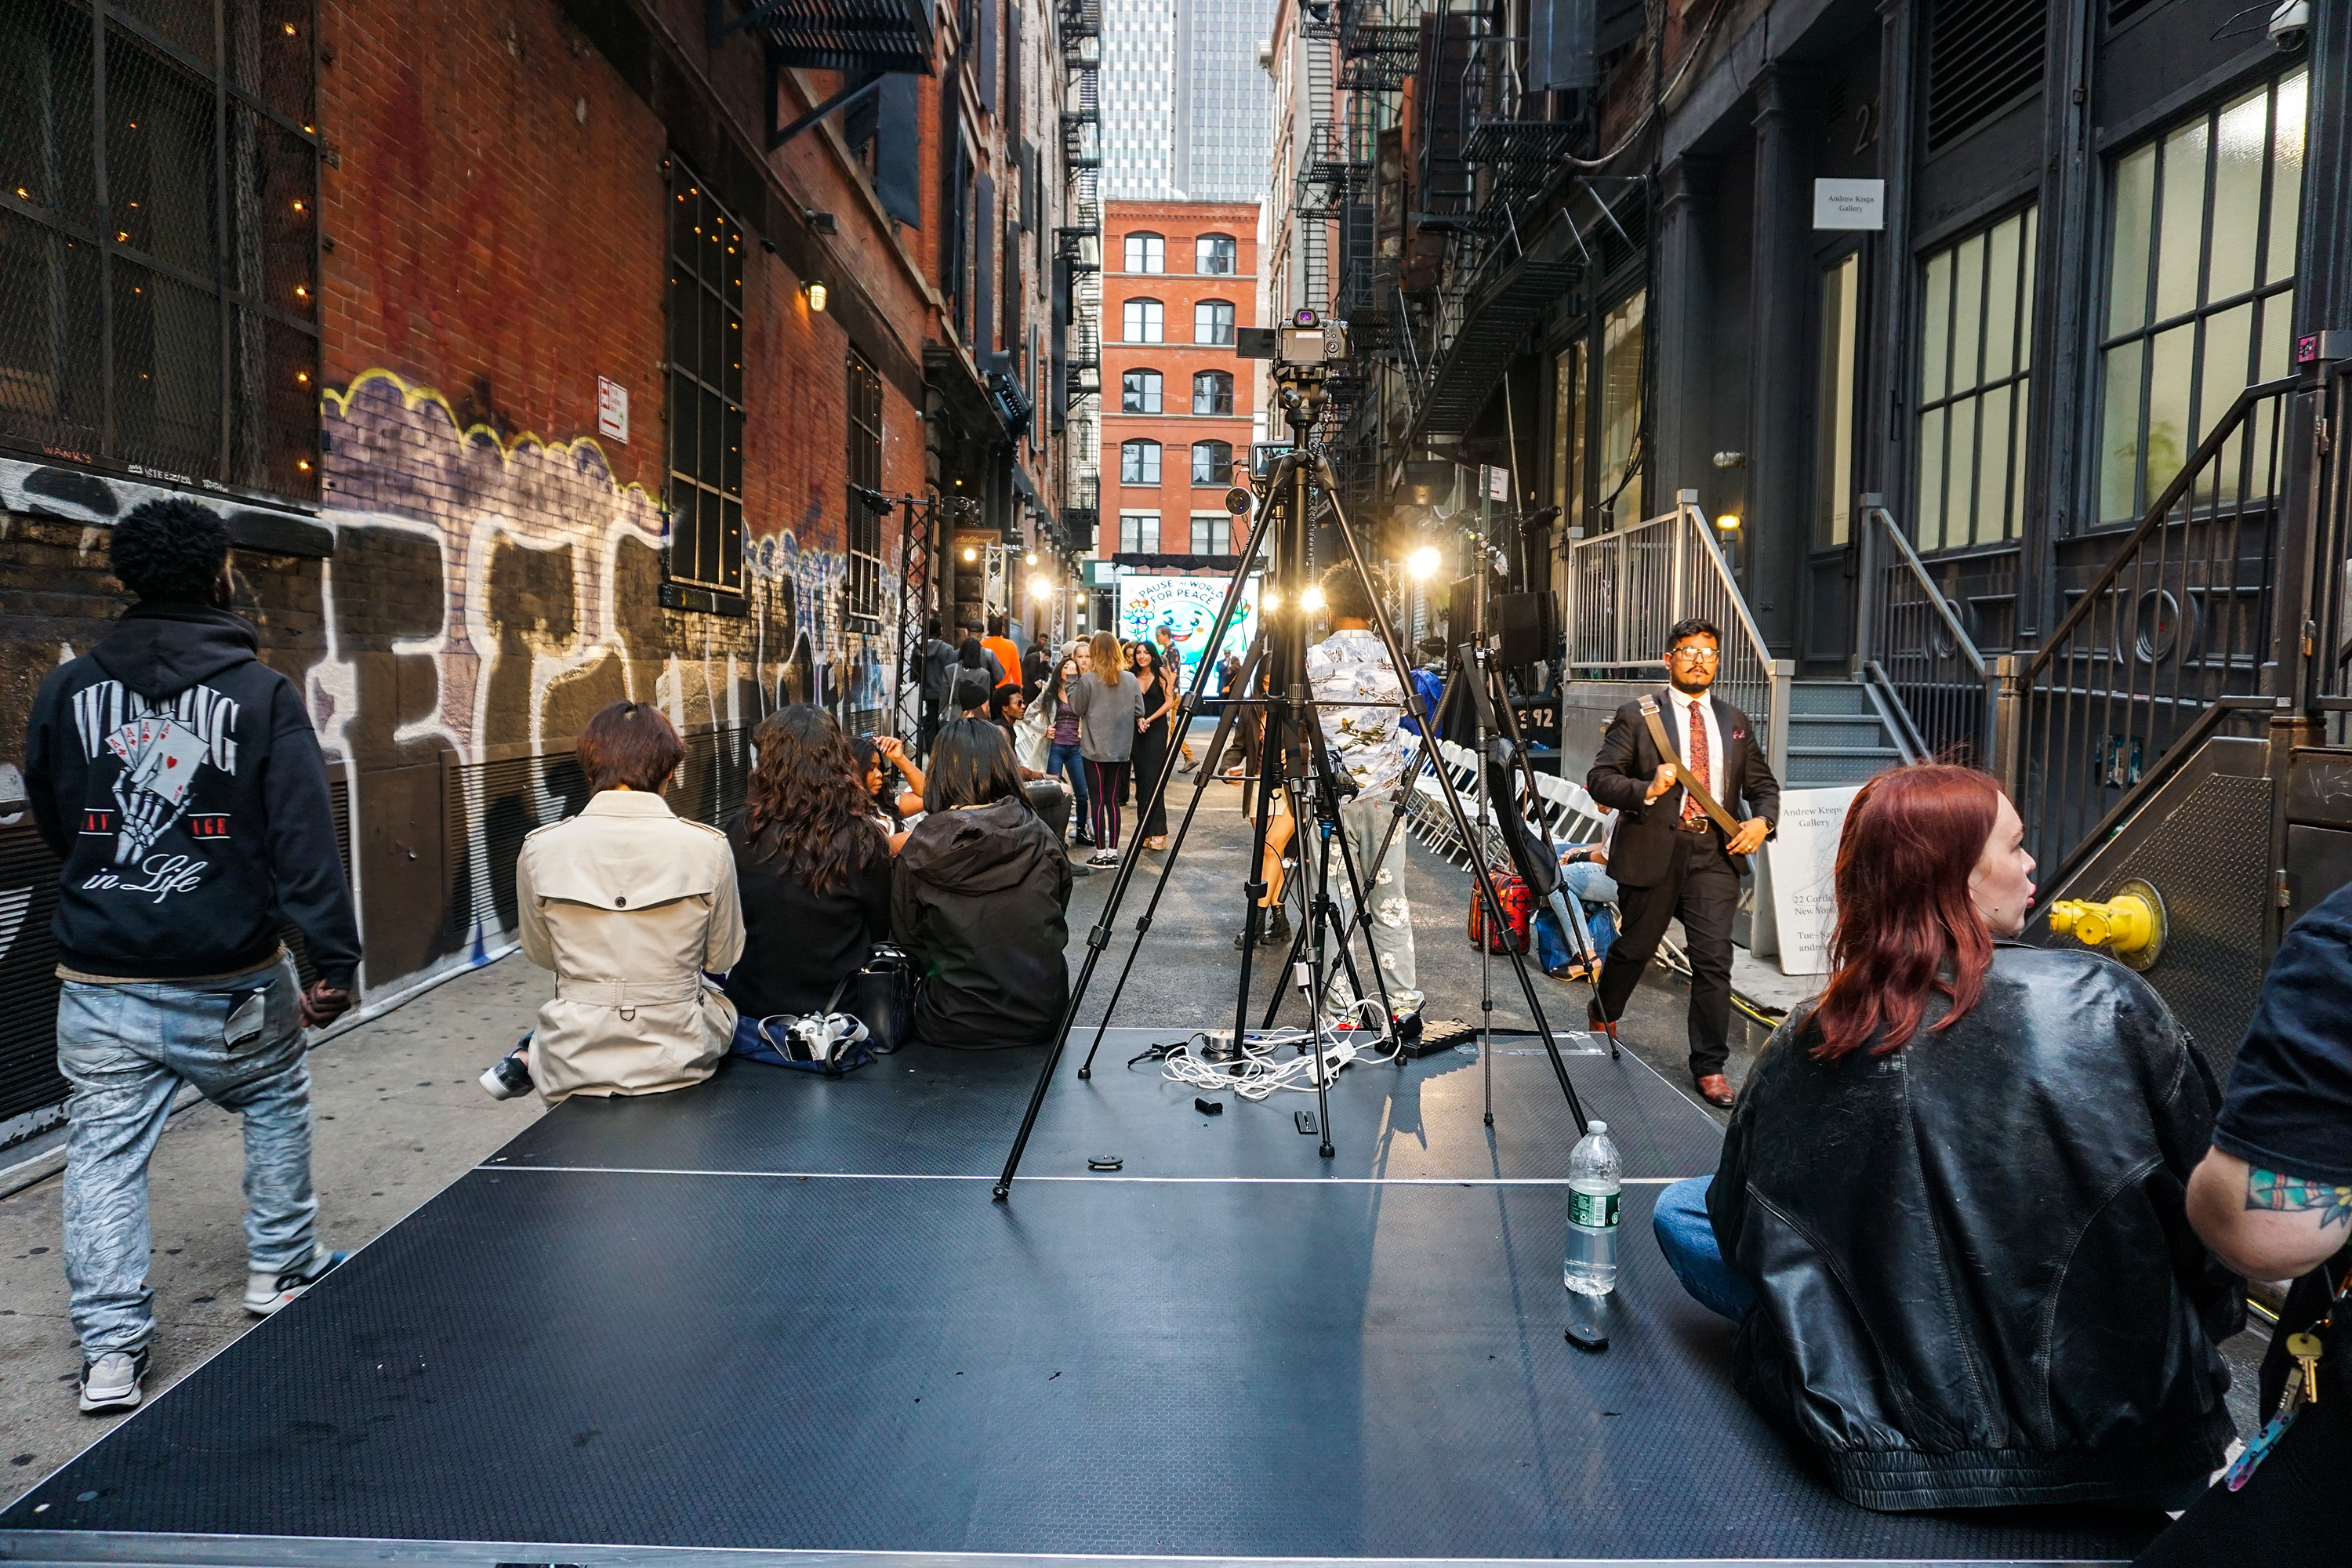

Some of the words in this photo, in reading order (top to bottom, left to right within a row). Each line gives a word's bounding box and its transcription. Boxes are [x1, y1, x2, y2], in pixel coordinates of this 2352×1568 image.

[42, 444, 92, 463] WANKY
[1138, 579, 1173, 597] PAUSE
[1189, 581, 1223, 598] WORLD
[1150, 590, 1173, 604] FOR
[1177, 589, 1214, 604] PEACE
[1818, 806, 1844, 815] Kreps
[1798, 819, 1831, 828] Gallery
[82, 867, 119, 890] in
[119, 854, 208, 903] Life
